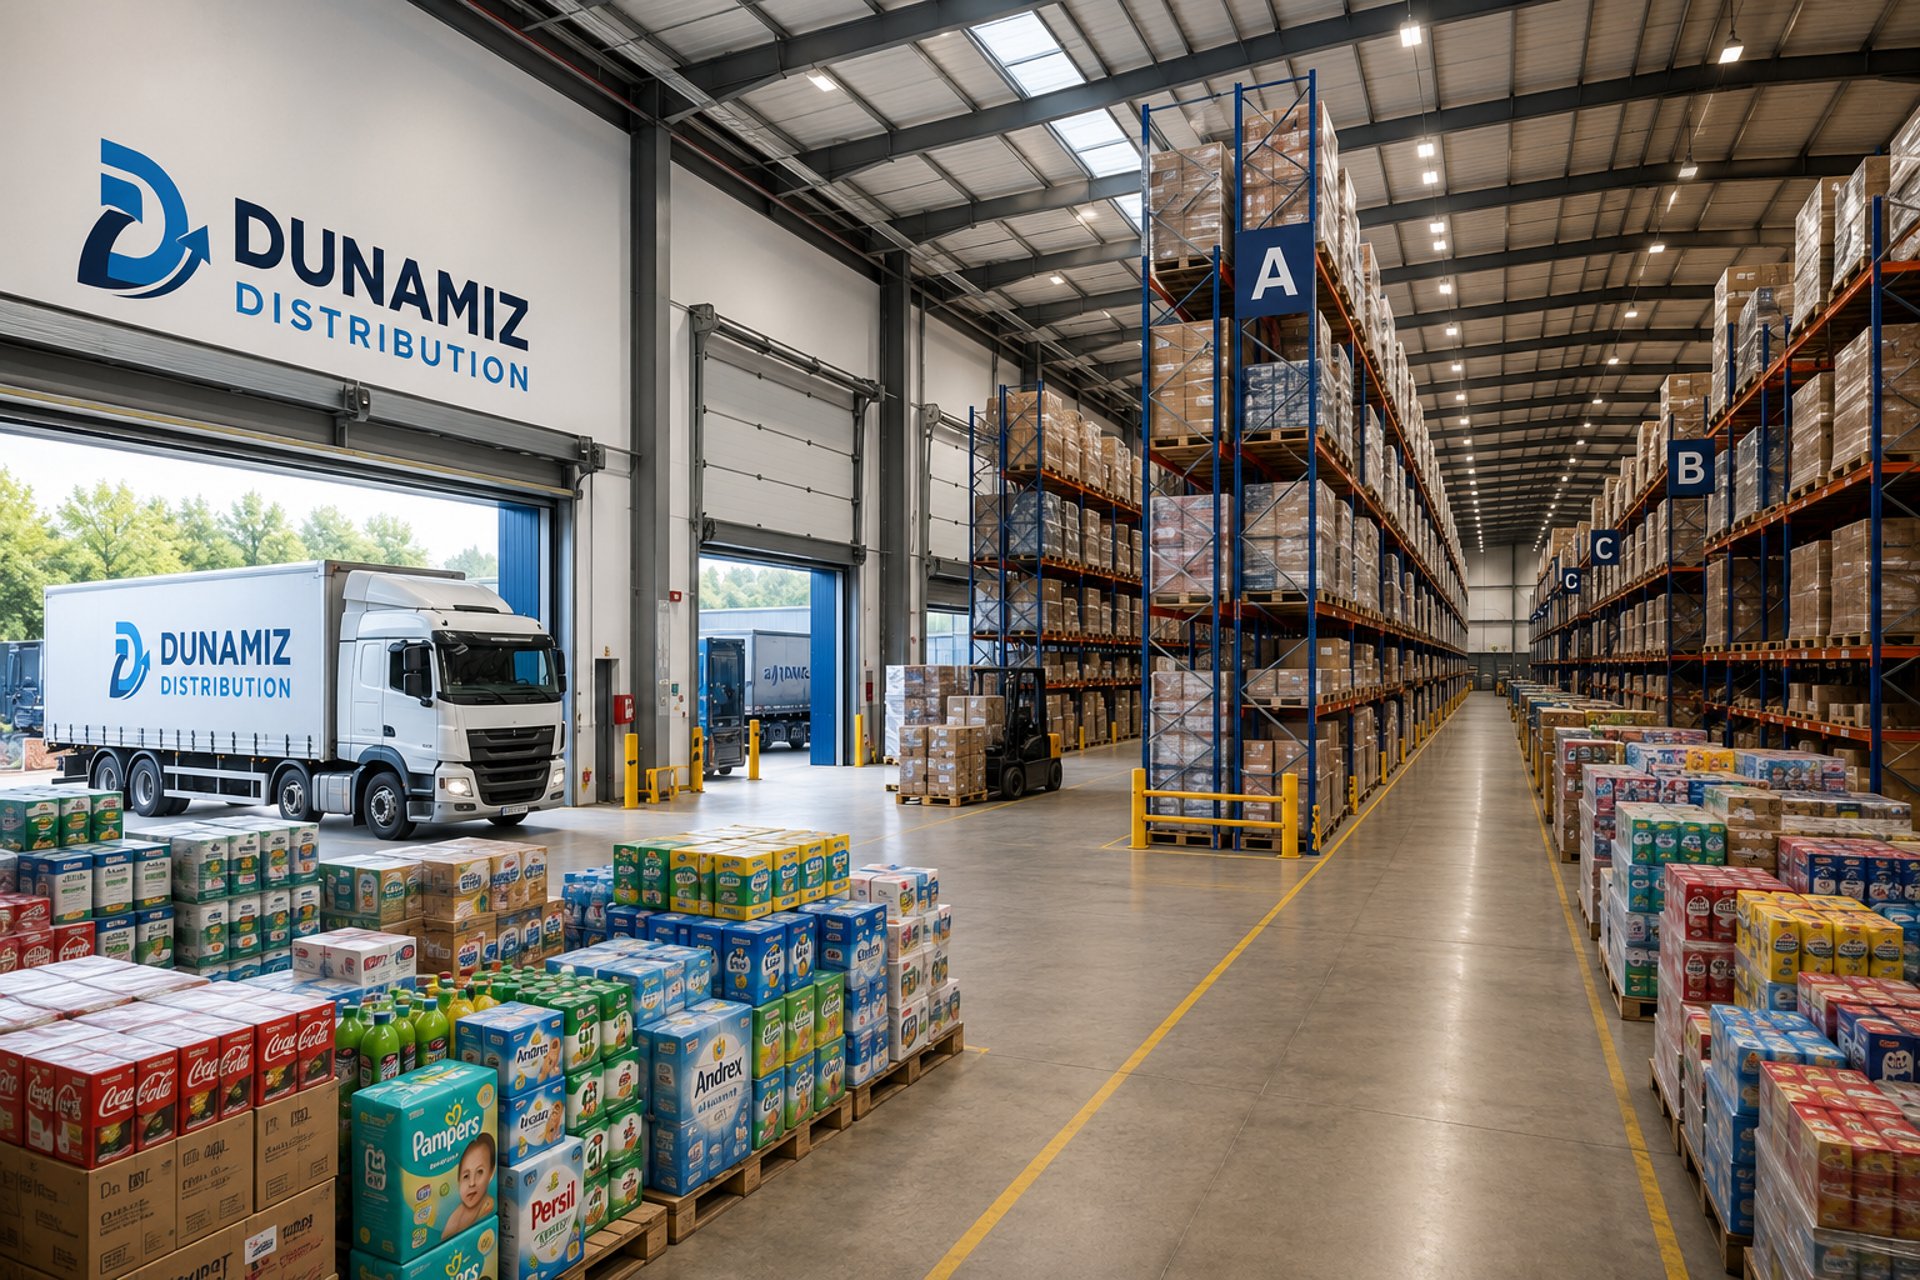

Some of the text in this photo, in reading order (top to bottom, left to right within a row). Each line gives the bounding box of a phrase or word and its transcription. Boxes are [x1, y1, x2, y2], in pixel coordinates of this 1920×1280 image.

[235, 197, 529, 351] DUNAMIZ
[1251, 247, 1298, 300] A
[236, 281, 529, 391] DISTRIBUTION
[1677, 451, 1705, 485] B
[1595, 537, 1613, 560] C
[1565, 573, 1578, 590] C
[161, 628, 291, 667] DUNAMIZ
[161, 677, 291, 699] DISTRIBUTION
[695, 1057, 743, 1099] Andrex
[412, 1115, 481, 1162] Pampers
[531, 1179, 576, 1231] Persil
